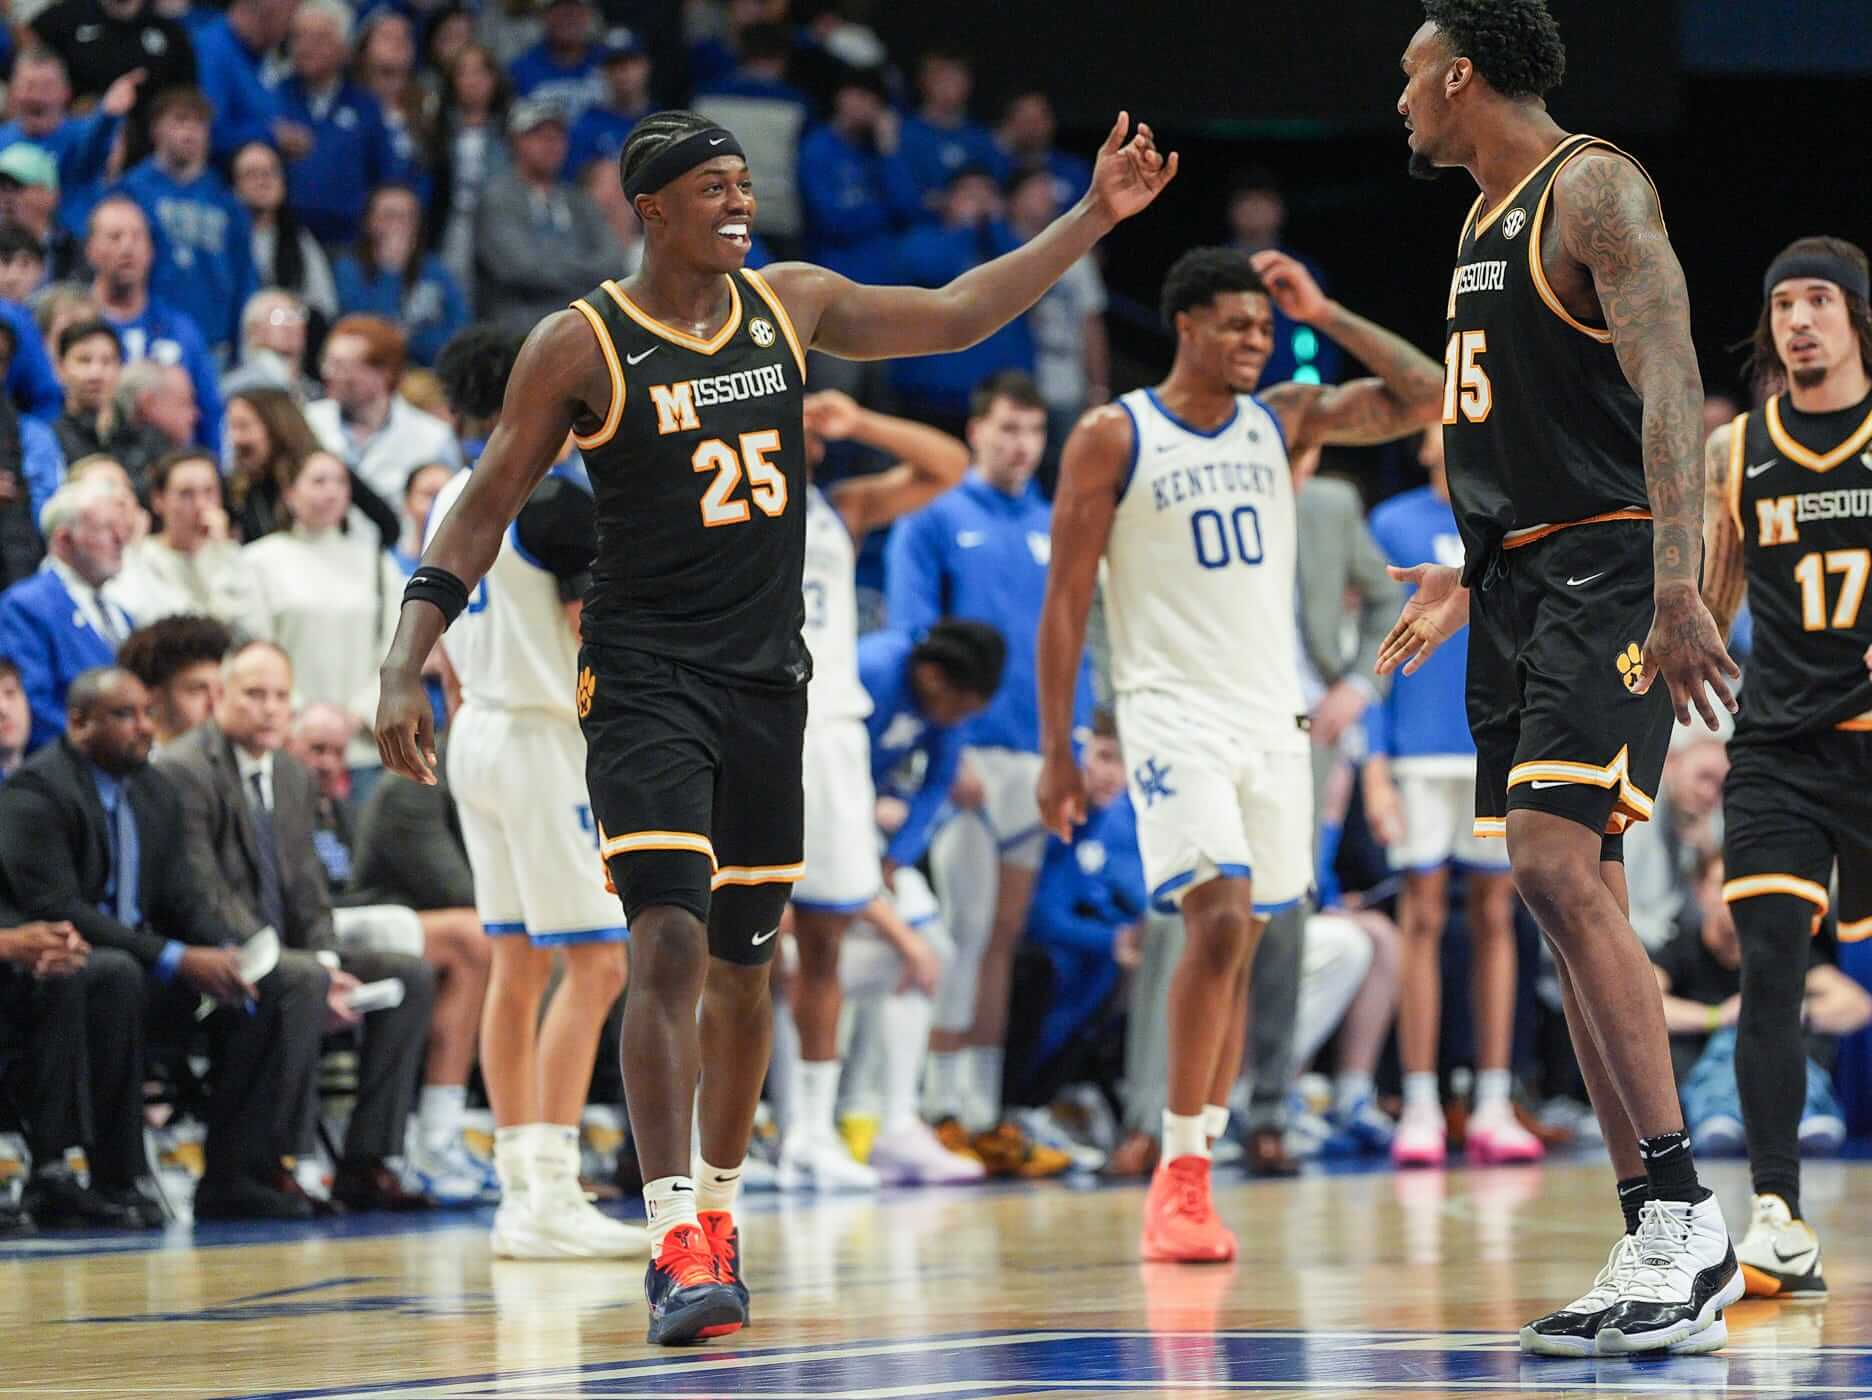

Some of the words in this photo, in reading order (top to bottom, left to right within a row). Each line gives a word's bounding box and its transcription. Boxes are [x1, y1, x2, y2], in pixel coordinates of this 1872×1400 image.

[1503, 209, 1525, 238] SEC
[751, 319, 773, 346] SEC
[649, 363, 787, 435] MISSOURI
[1441, 330, 1493, 424] 15
[691, 429, 788, 528] 25
[1152, 462, 1274, 511] KENTUCKY
[1191, 506, 1264, 568] 00
[1756, 488, 1872, 547] MISSOU
[1794, 548, 1871, 631] 17
